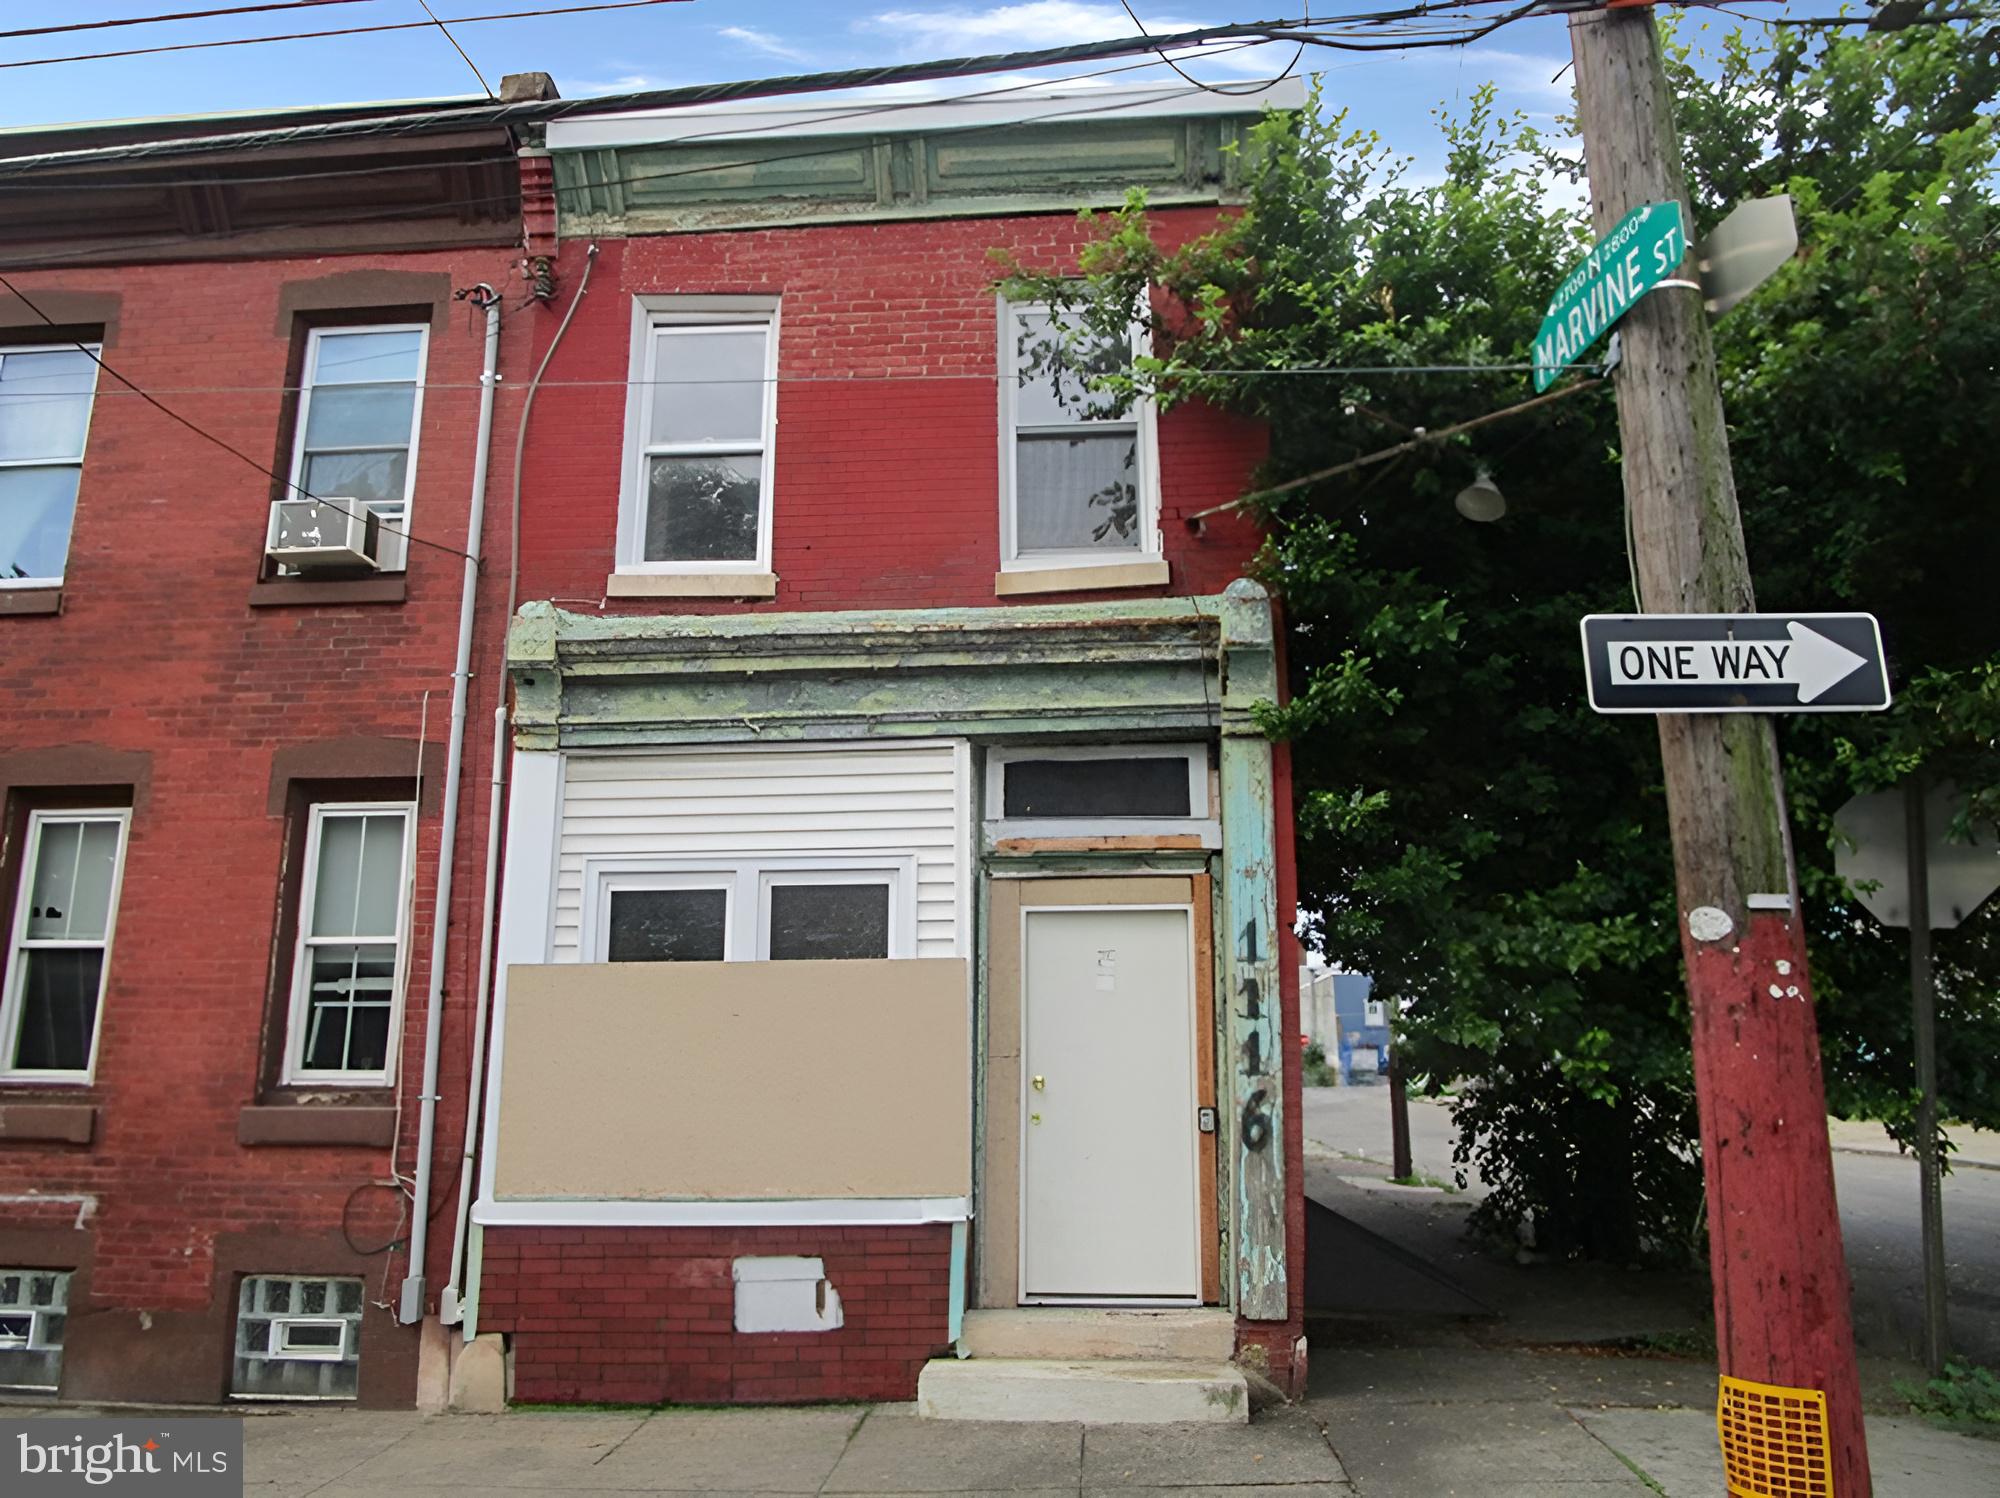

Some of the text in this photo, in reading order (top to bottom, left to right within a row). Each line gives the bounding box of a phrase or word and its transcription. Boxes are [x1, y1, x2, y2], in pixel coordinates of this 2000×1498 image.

[1537, 227, 1676, 385] MARVINE ST
[1588, 249, 1601, 279] N
[1620, 645, 1790, 680] ONE WAY
[1236, 917, 1273, 1151] 1116
